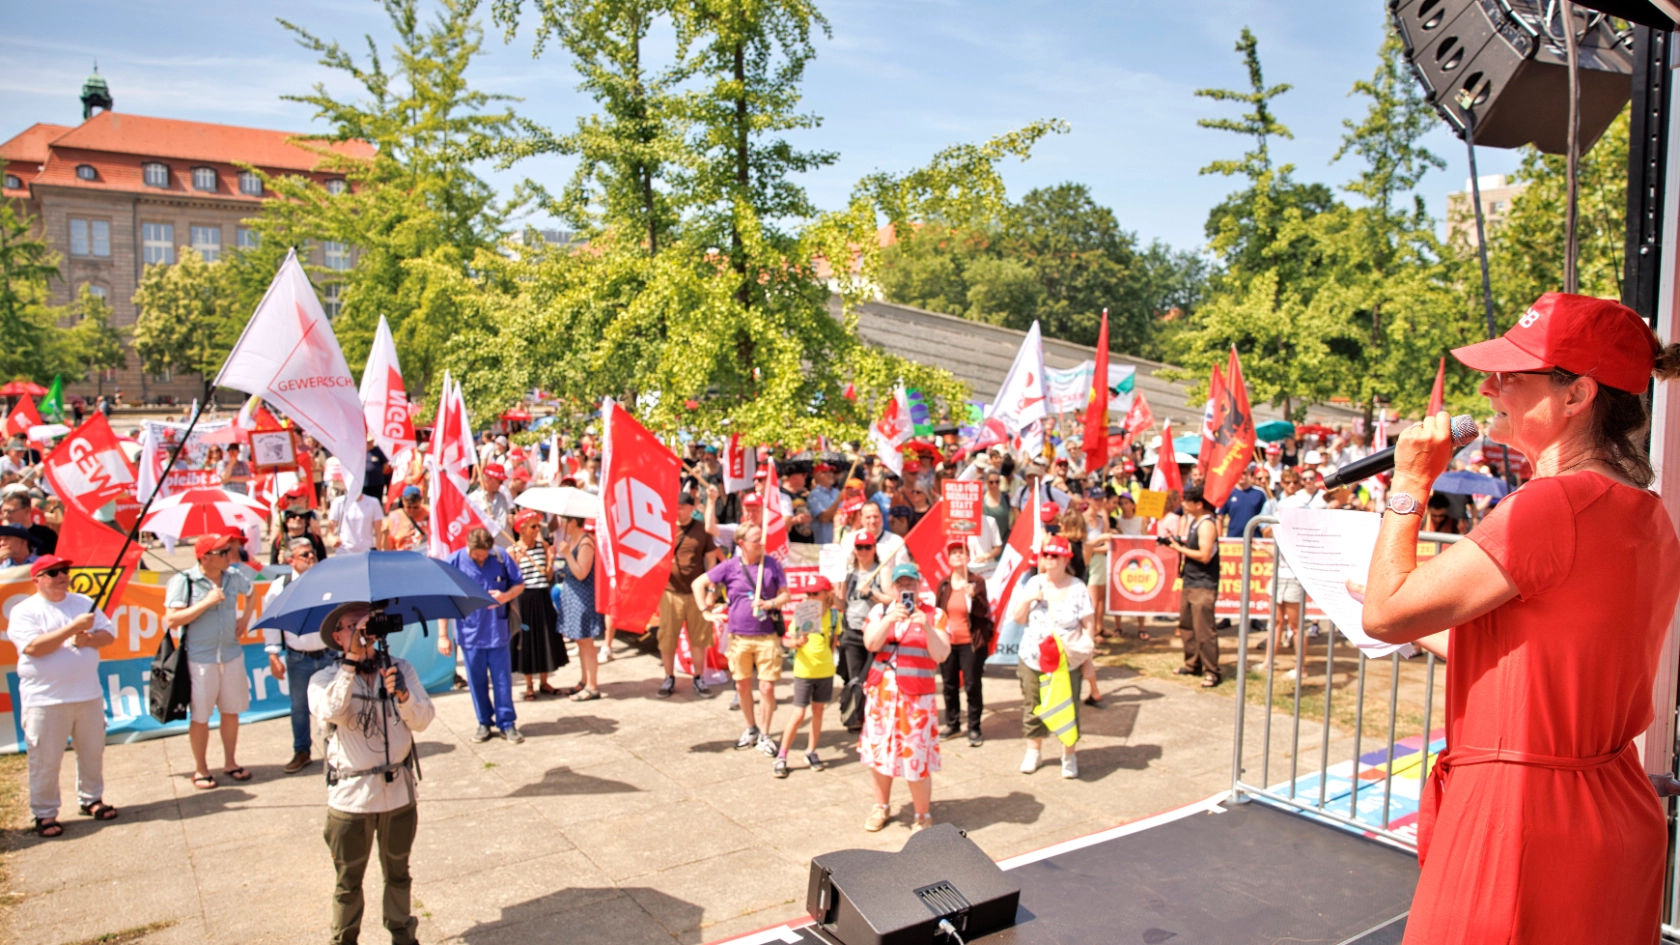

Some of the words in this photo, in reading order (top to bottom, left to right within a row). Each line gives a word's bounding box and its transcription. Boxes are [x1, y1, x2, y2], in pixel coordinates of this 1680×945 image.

[277, 376, 356, 392] GEWERKSCH
[69, 437, 122, 497] GEW
[167, 473, 207, 487] bleibt
[965, 481, 979, 492] FÜR
[950, 501, 973, 509] STATT
[1127, 574, 1151, 583] DIDF
